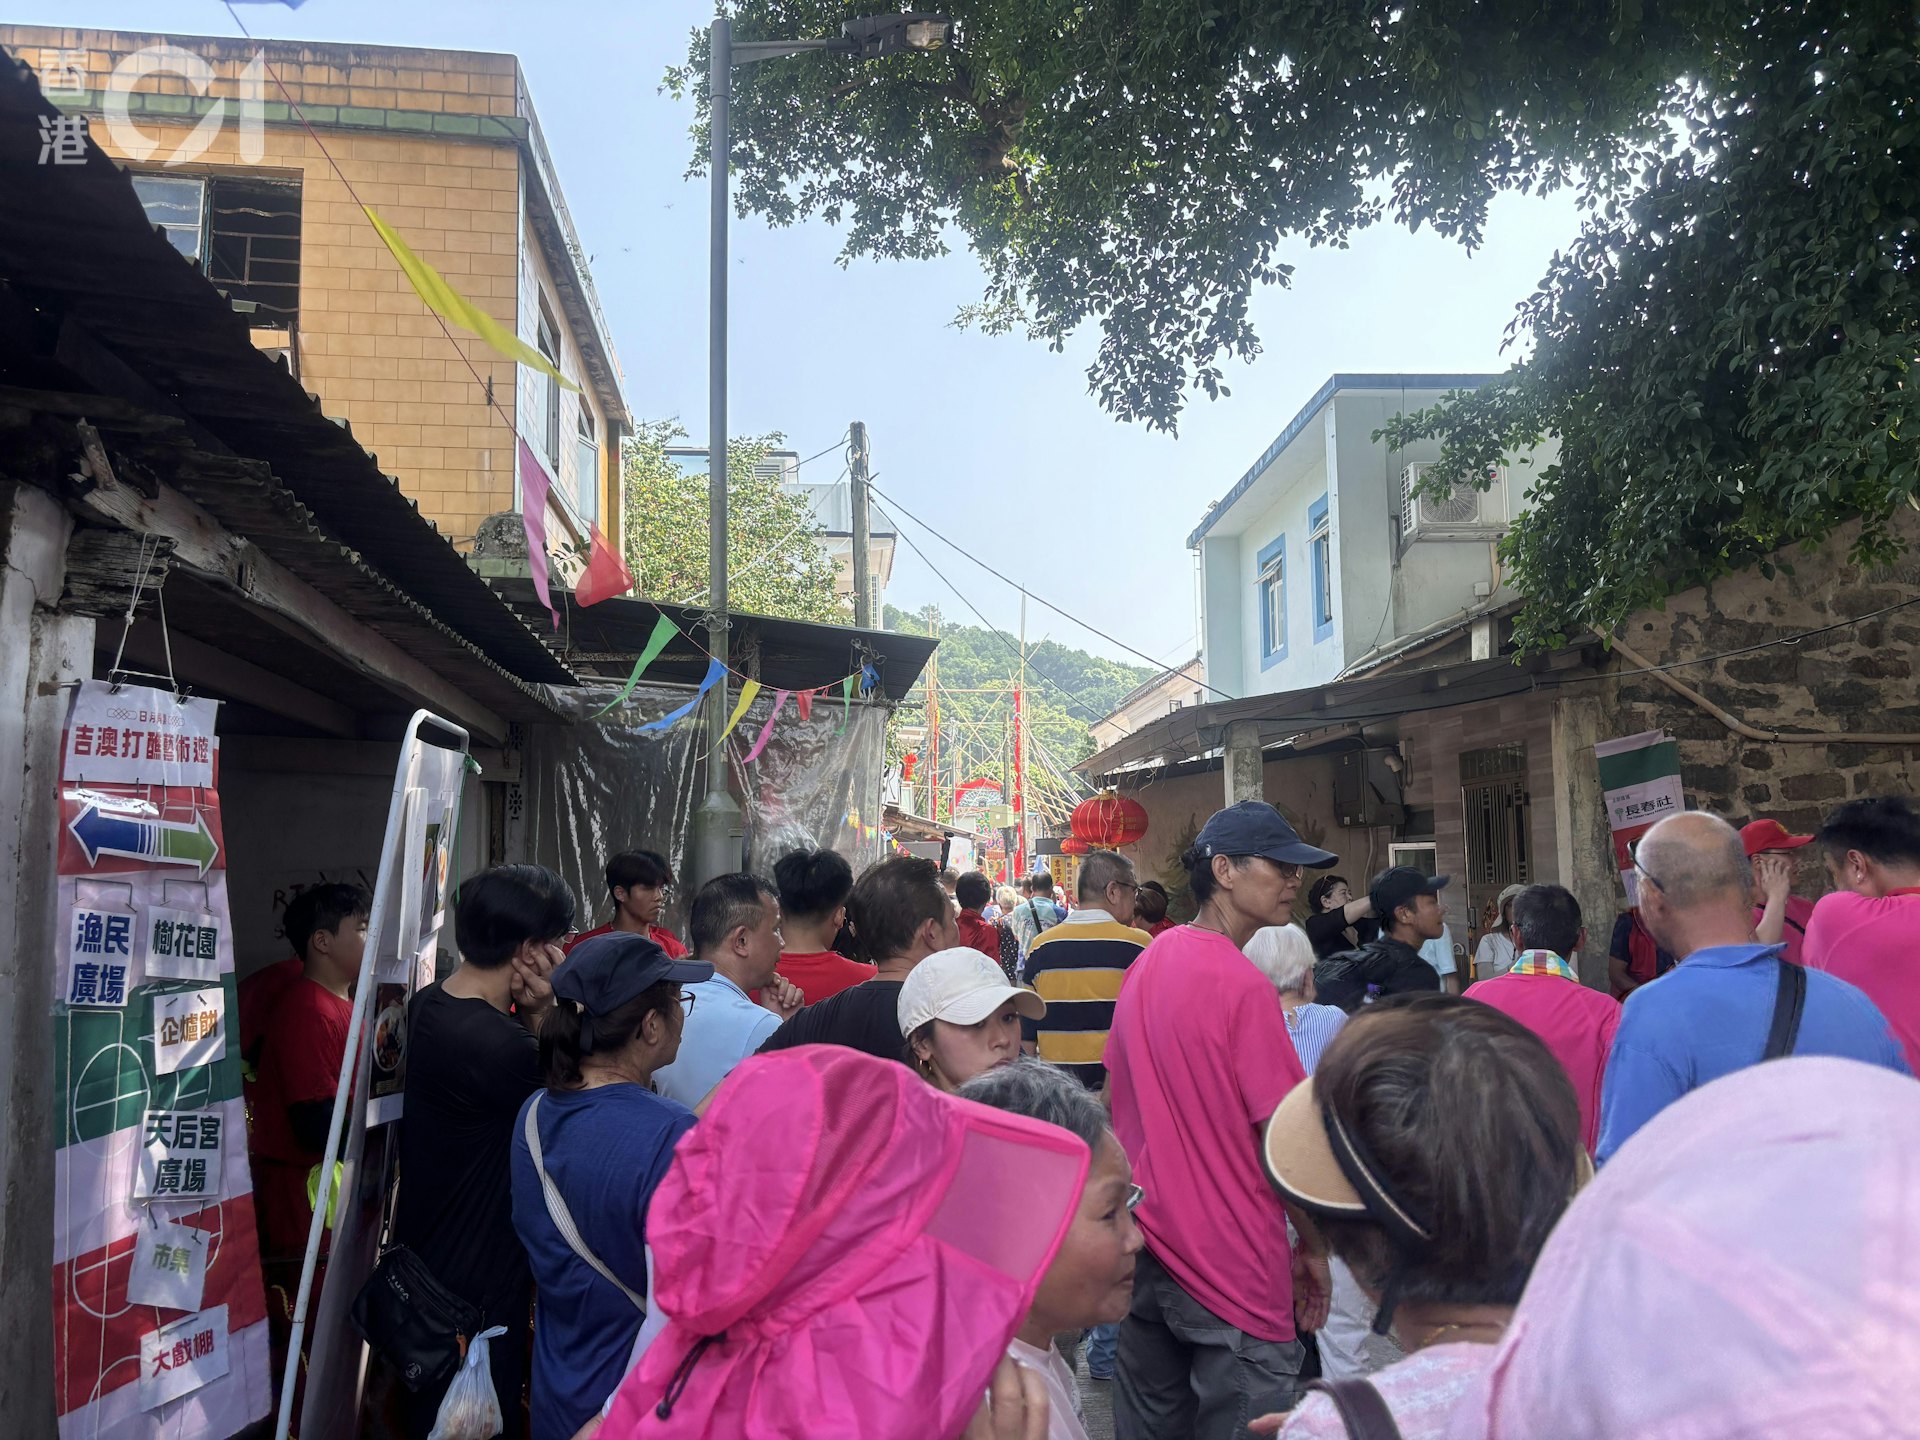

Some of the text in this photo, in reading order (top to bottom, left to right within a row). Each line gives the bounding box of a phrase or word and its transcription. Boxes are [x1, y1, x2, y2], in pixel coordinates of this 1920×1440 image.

[74, 724, 209, 764] 吉澳打醮藝術遊
[1626, 795, 1673, 816] 長春社
[75, 912, 131, 956] 漁民
[153, 919, 218, 961] 樹花園
[71, 962, 127, 1004] 廣場
[160, 1010, 218, 1047] 企爐餅
[144, 1114, 220, 1150] 天后宮
[152, 1158, 207, 1195] 廣場
[152, 1242, 191, 1275] 市集
[152, 1329, 215, 1378] 大戲棚
